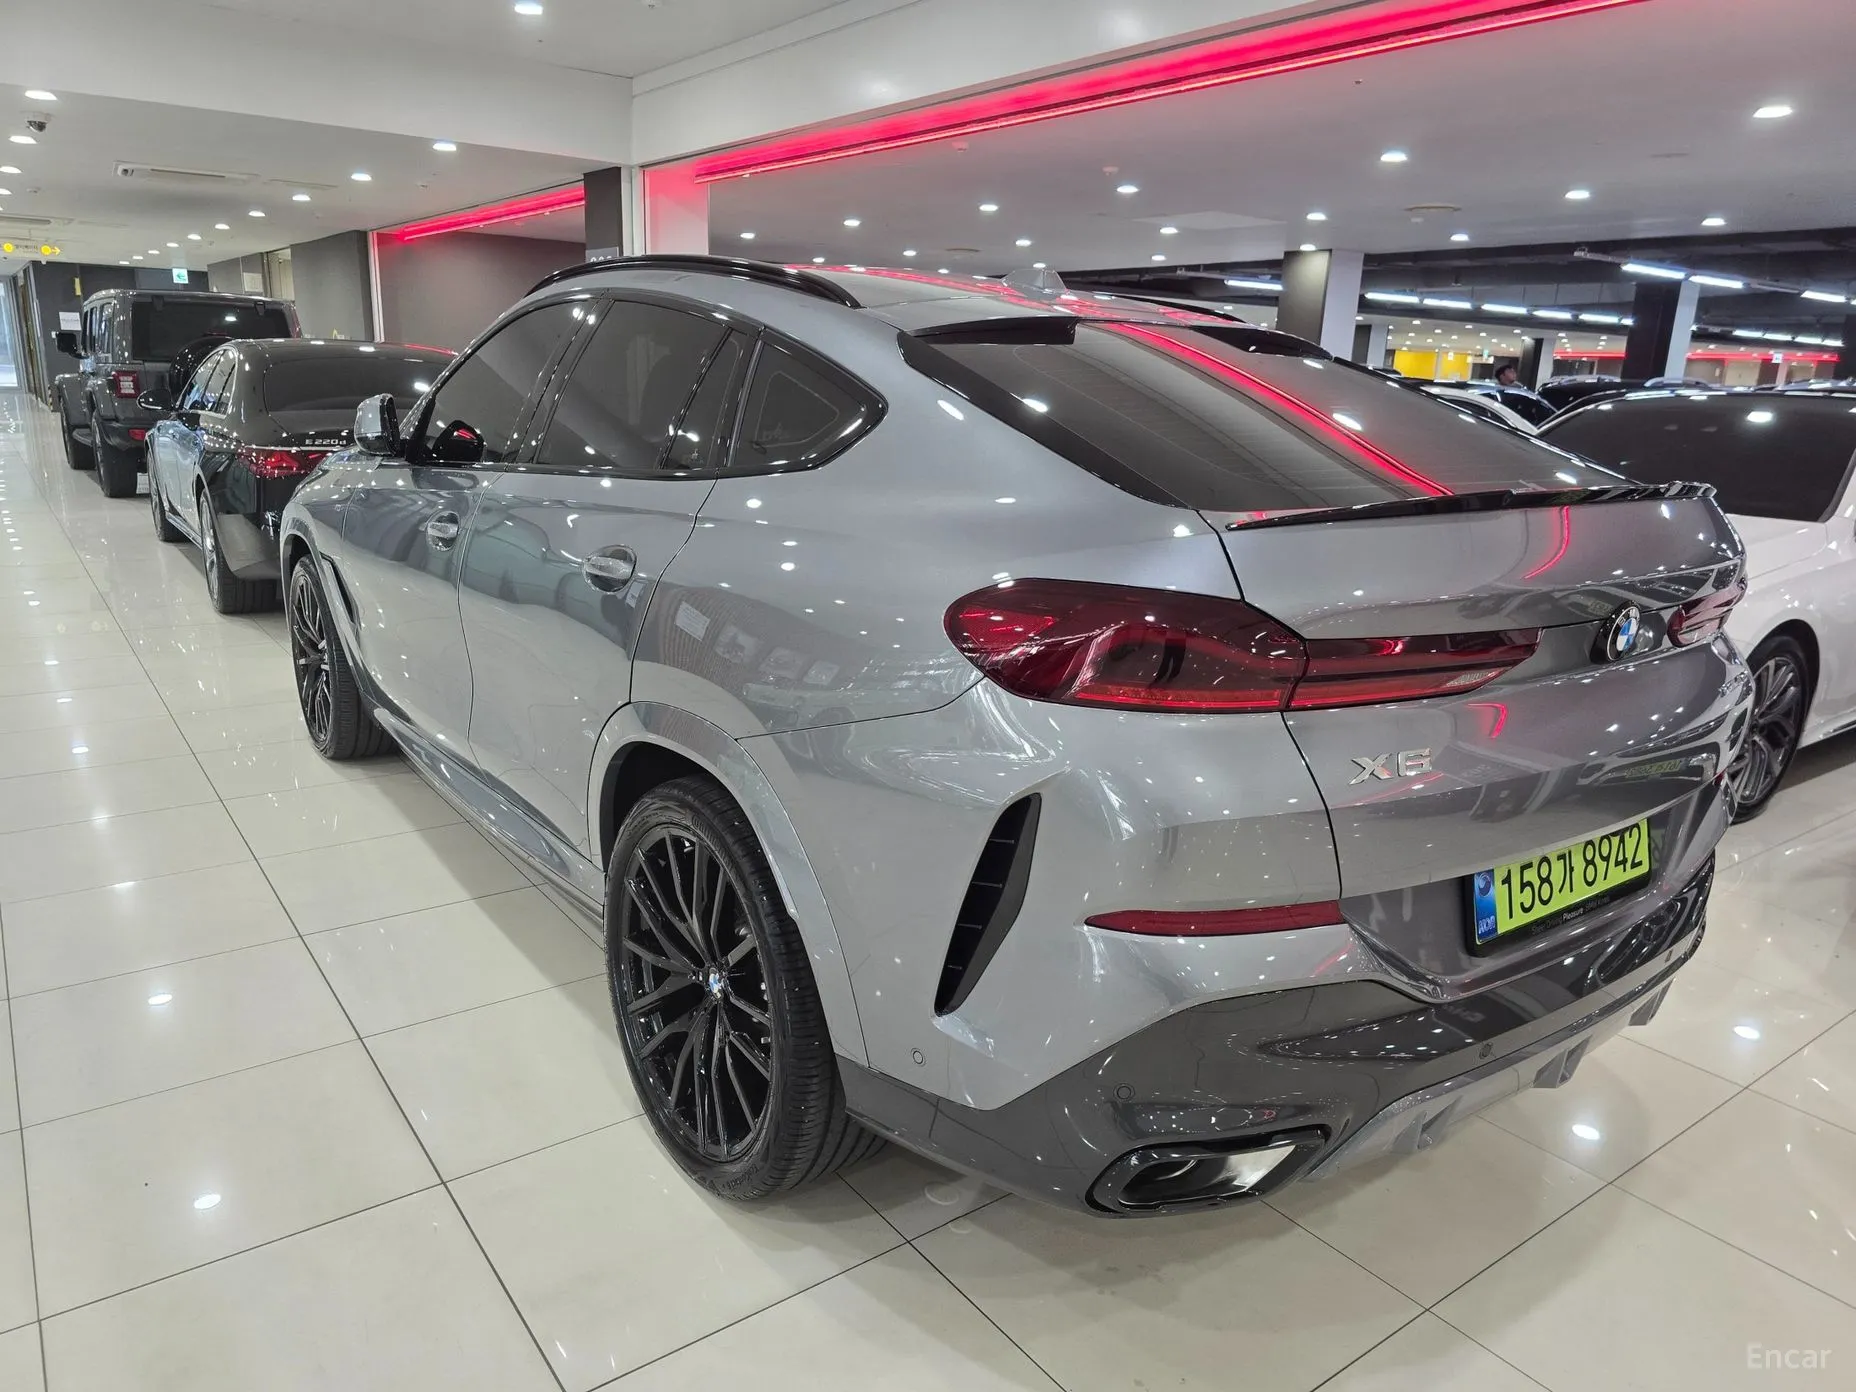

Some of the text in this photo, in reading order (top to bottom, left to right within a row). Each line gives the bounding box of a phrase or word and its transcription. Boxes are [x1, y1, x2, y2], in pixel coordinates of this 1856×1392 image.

[1347, 747, 1433, 785] X6
[1501, 822, 1643, 920] 158가 8942
